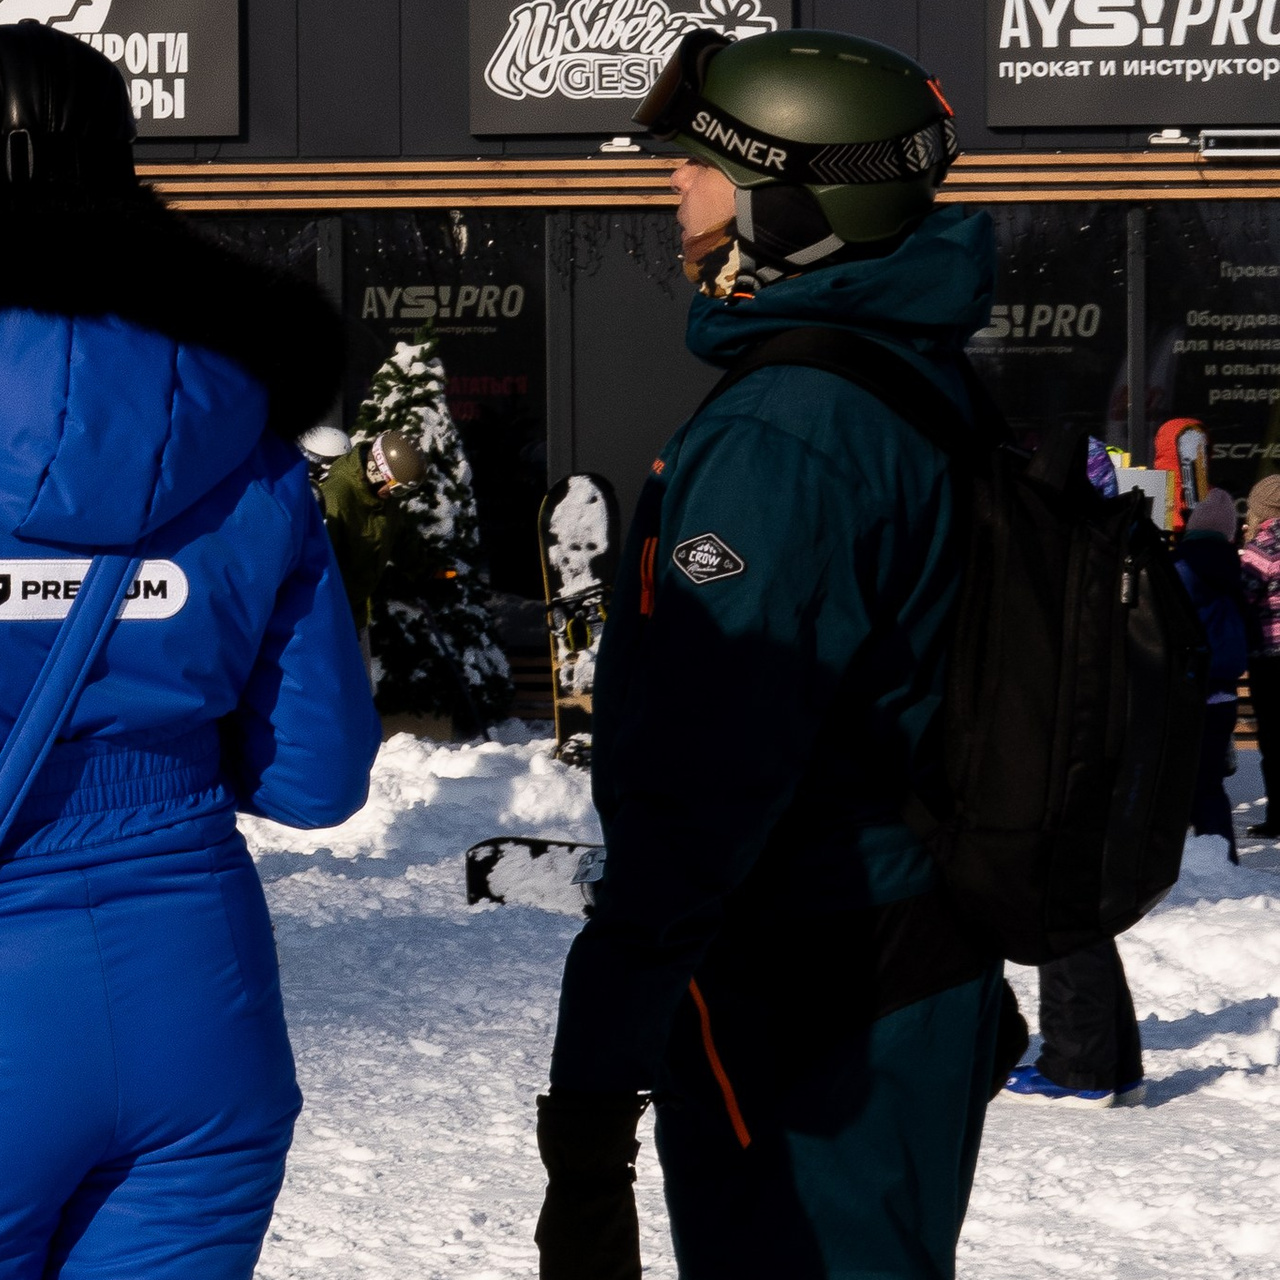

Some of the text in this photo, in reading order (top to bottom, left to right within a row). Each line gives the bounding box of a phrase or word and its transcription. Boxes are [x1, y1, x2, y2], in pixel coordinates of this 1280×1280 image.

[74, 32, 188, 74] РОГИ
[999, 59, 1093, 84] прокат
[1099, 60, 1115, 76] и
[126, 78, 185, 119] РЫ
[691, 110, 788, 172] SINNER
[361, 283, 526, 320] AYS!PRO
[968, 302, 1102, 338] S!PRO
[1172, 338, 1209, 354] для
[1204, 364, 1217, 376] и
[21, 579, 168, 600] PREUM
